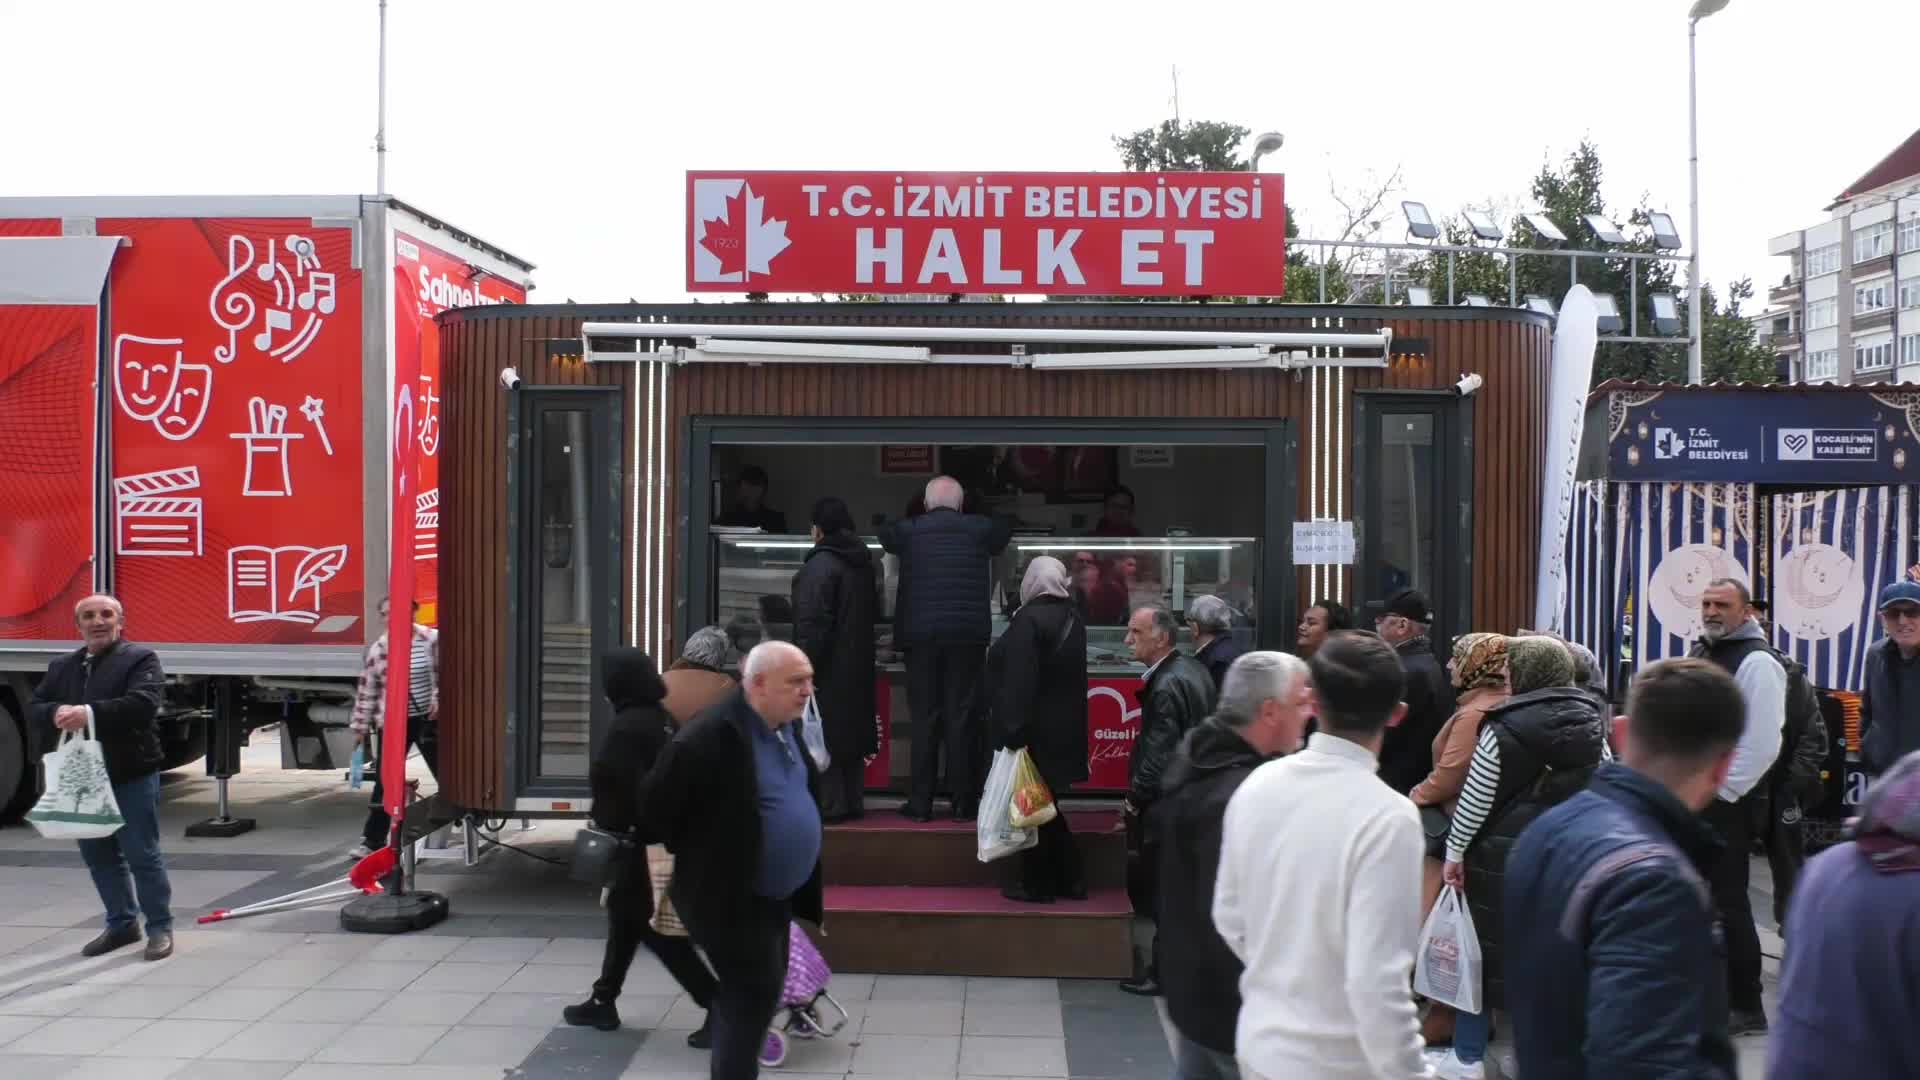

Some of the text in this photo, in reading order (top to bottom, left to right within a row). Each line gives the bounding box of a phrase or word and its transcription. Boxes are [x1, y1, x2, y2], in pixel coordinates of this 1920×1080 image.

[801, 176, 1263, 219] T.C. İZMİT BELEDİYESİ
[855, 227, 1215, 286] HALK ET
[419, 264, 473, 308] Sahne
[1688, 427, 1711, 437] T.C.
[1688, 437, 1719, 448] İZMİT
[1688, 448, 1749, 460] BELEDİYESİ
[1094, 728, 1130, 740] Güzel
